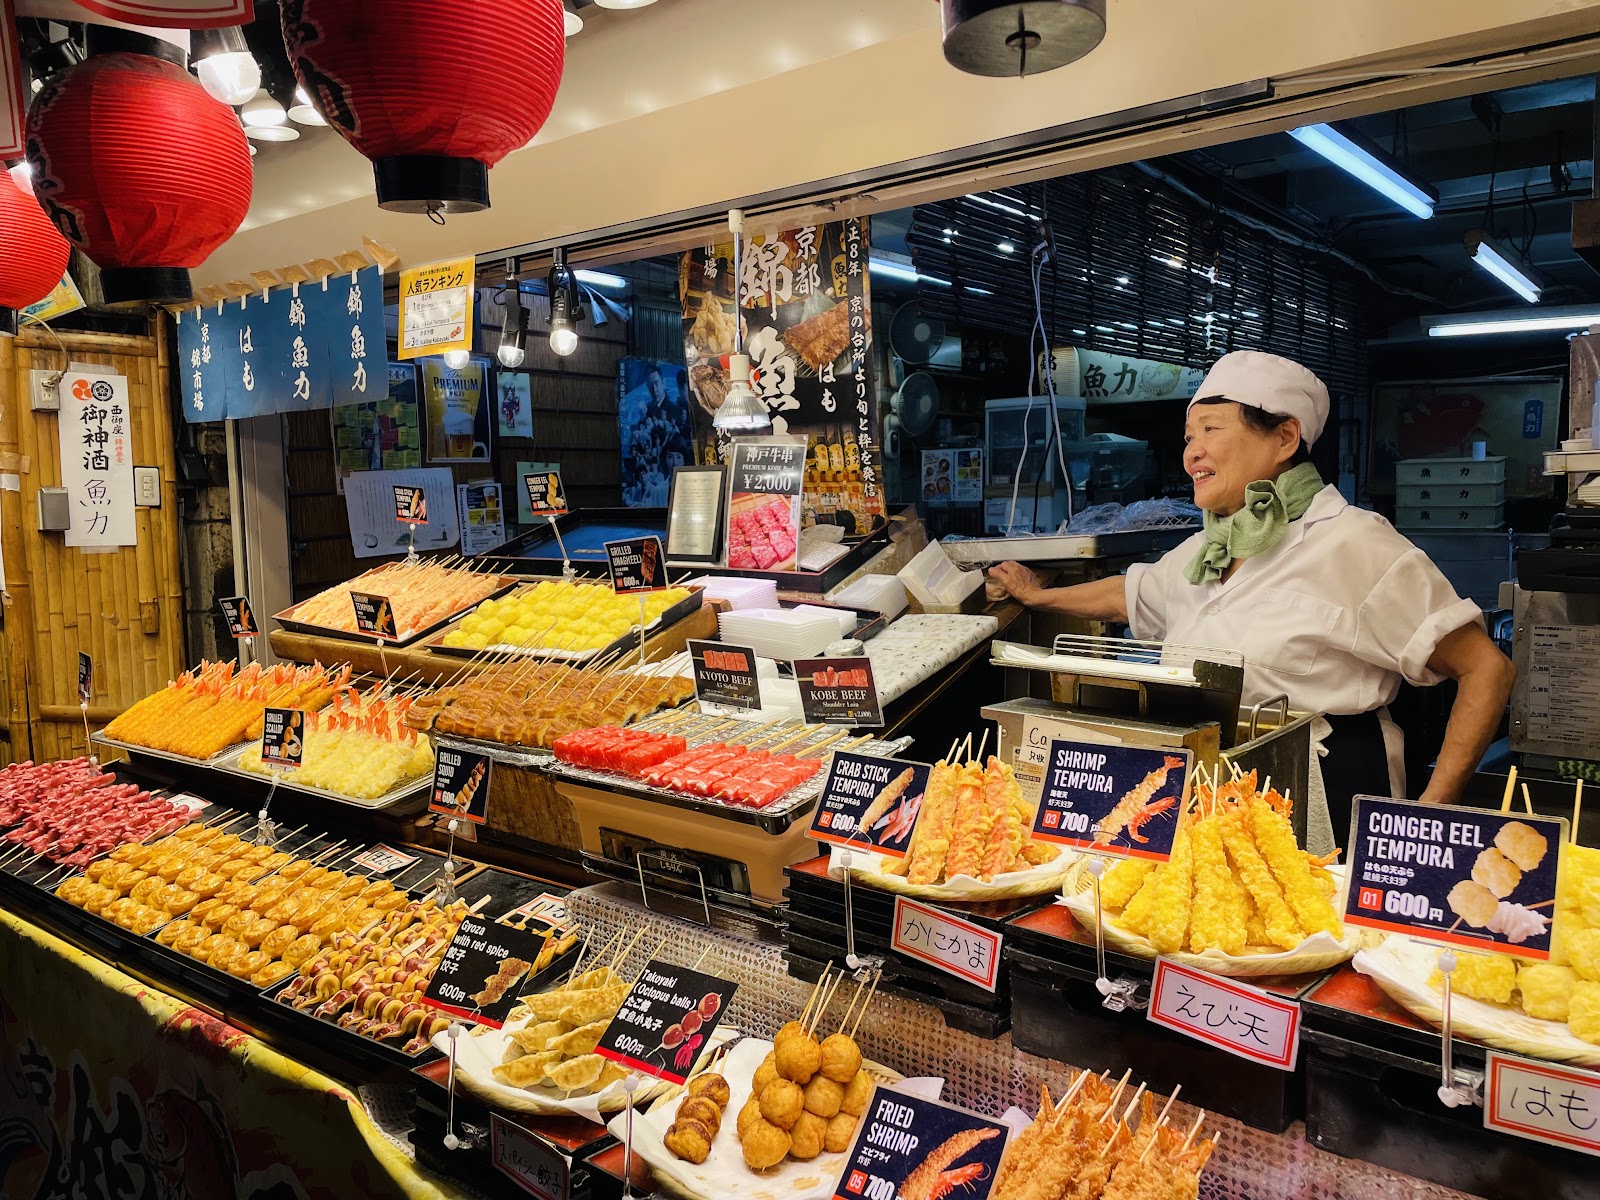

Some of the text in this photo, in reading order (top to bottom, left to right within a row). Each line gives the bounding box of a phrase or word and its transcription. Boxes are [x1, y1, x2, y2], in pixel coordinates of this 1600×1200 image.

[795, 226, 821, 295] 京都
[407, 270, 465, 295] 人気ランキング
[289, 298, 310, 401] 錦魚力
[347, 285, 367, 393] 錦魚力
[238, 325, 254, 392] はも
[190, 348, 204, 412] 錦市場
[433, 376, 479, 391] PREMIUM
[818, 362, 837, 412] はも
[1083, 362, 1139, 397] 魚力
[80, 403, 109, 471] 御神酒
[746, 446, 793, 463] 神戸牛串
[744, 474, 792, 491] ¥2,000
[80, 479, 111, 535] 魚力
[610, 545, 632, 557] GRILLED
[699, 670, 753, 687] KYOTO BEEF
[810, 690, 867, 700] KOBE BEEF
[438, 764, 455, 778] SQUID
[440, 751, 462, 767] GRILLED
[836, 759, 891, 783] CRAB STICK
[1056, 749, 1107, 772] SHRIMP
[831, 776, 876, 799] TEMPURA
[1054, 768, 1114, 794] TEMPURA
[821, 813, 831, 825] 02
[1045, 813, 1057, 825] 03
[1368, 811, 1485, 848] CONGER EEL
[1366, 835, 1455, 869] TEMPURA
[1364, 861, 1415, 878] はもの天ぷら
[1363, 889, 1444, 922] 01 600円
[461, 920, 486, 936] Gyoza
[446, 946, 467, 961] 餃子
[453, 934, 510, 959] with red spice
[904, 918, 986, 969] かにかま
[641, 968, 678, 989] Takoyaki
[438, 983, 466, 1002] 600円
[633, 981, 698, 1011] (Octopus balls)
[1176, 984, 1270, 1046] えび天
[614, 1033, 645, 1056] 600円
[875, 1098, 915, 1129] FRIED
[1510, 1085, 1598, 1130] はも
[866, 1121, 919, 1156] SHRIMP
[861, 1146, 892, 1164] エビフライ
[850, 1174, 864, 1189] 05
